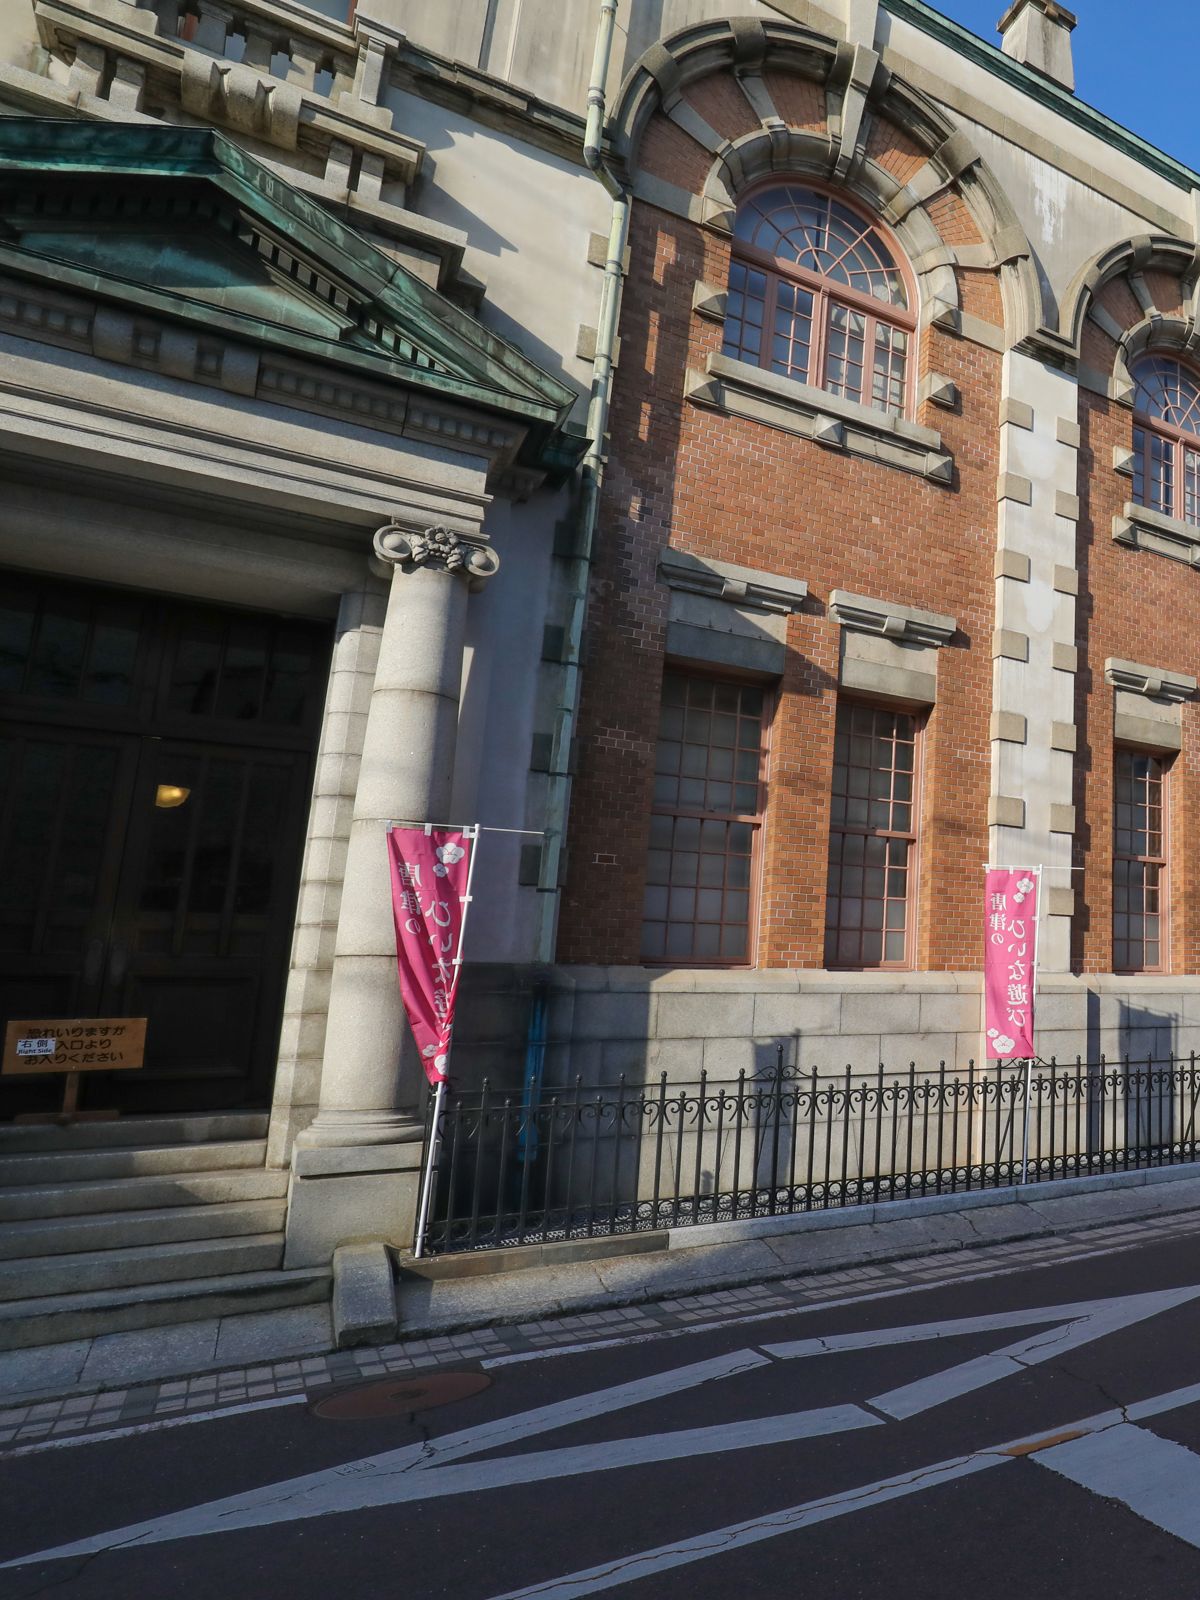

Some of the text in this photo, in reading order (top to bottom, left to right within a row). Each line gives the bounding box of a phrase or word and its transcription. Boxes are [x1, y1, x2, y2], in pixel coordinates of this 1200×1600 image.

[56, 1038, 112, 1051] 入口より
[24, 1052, 124, 1066] お入りください
